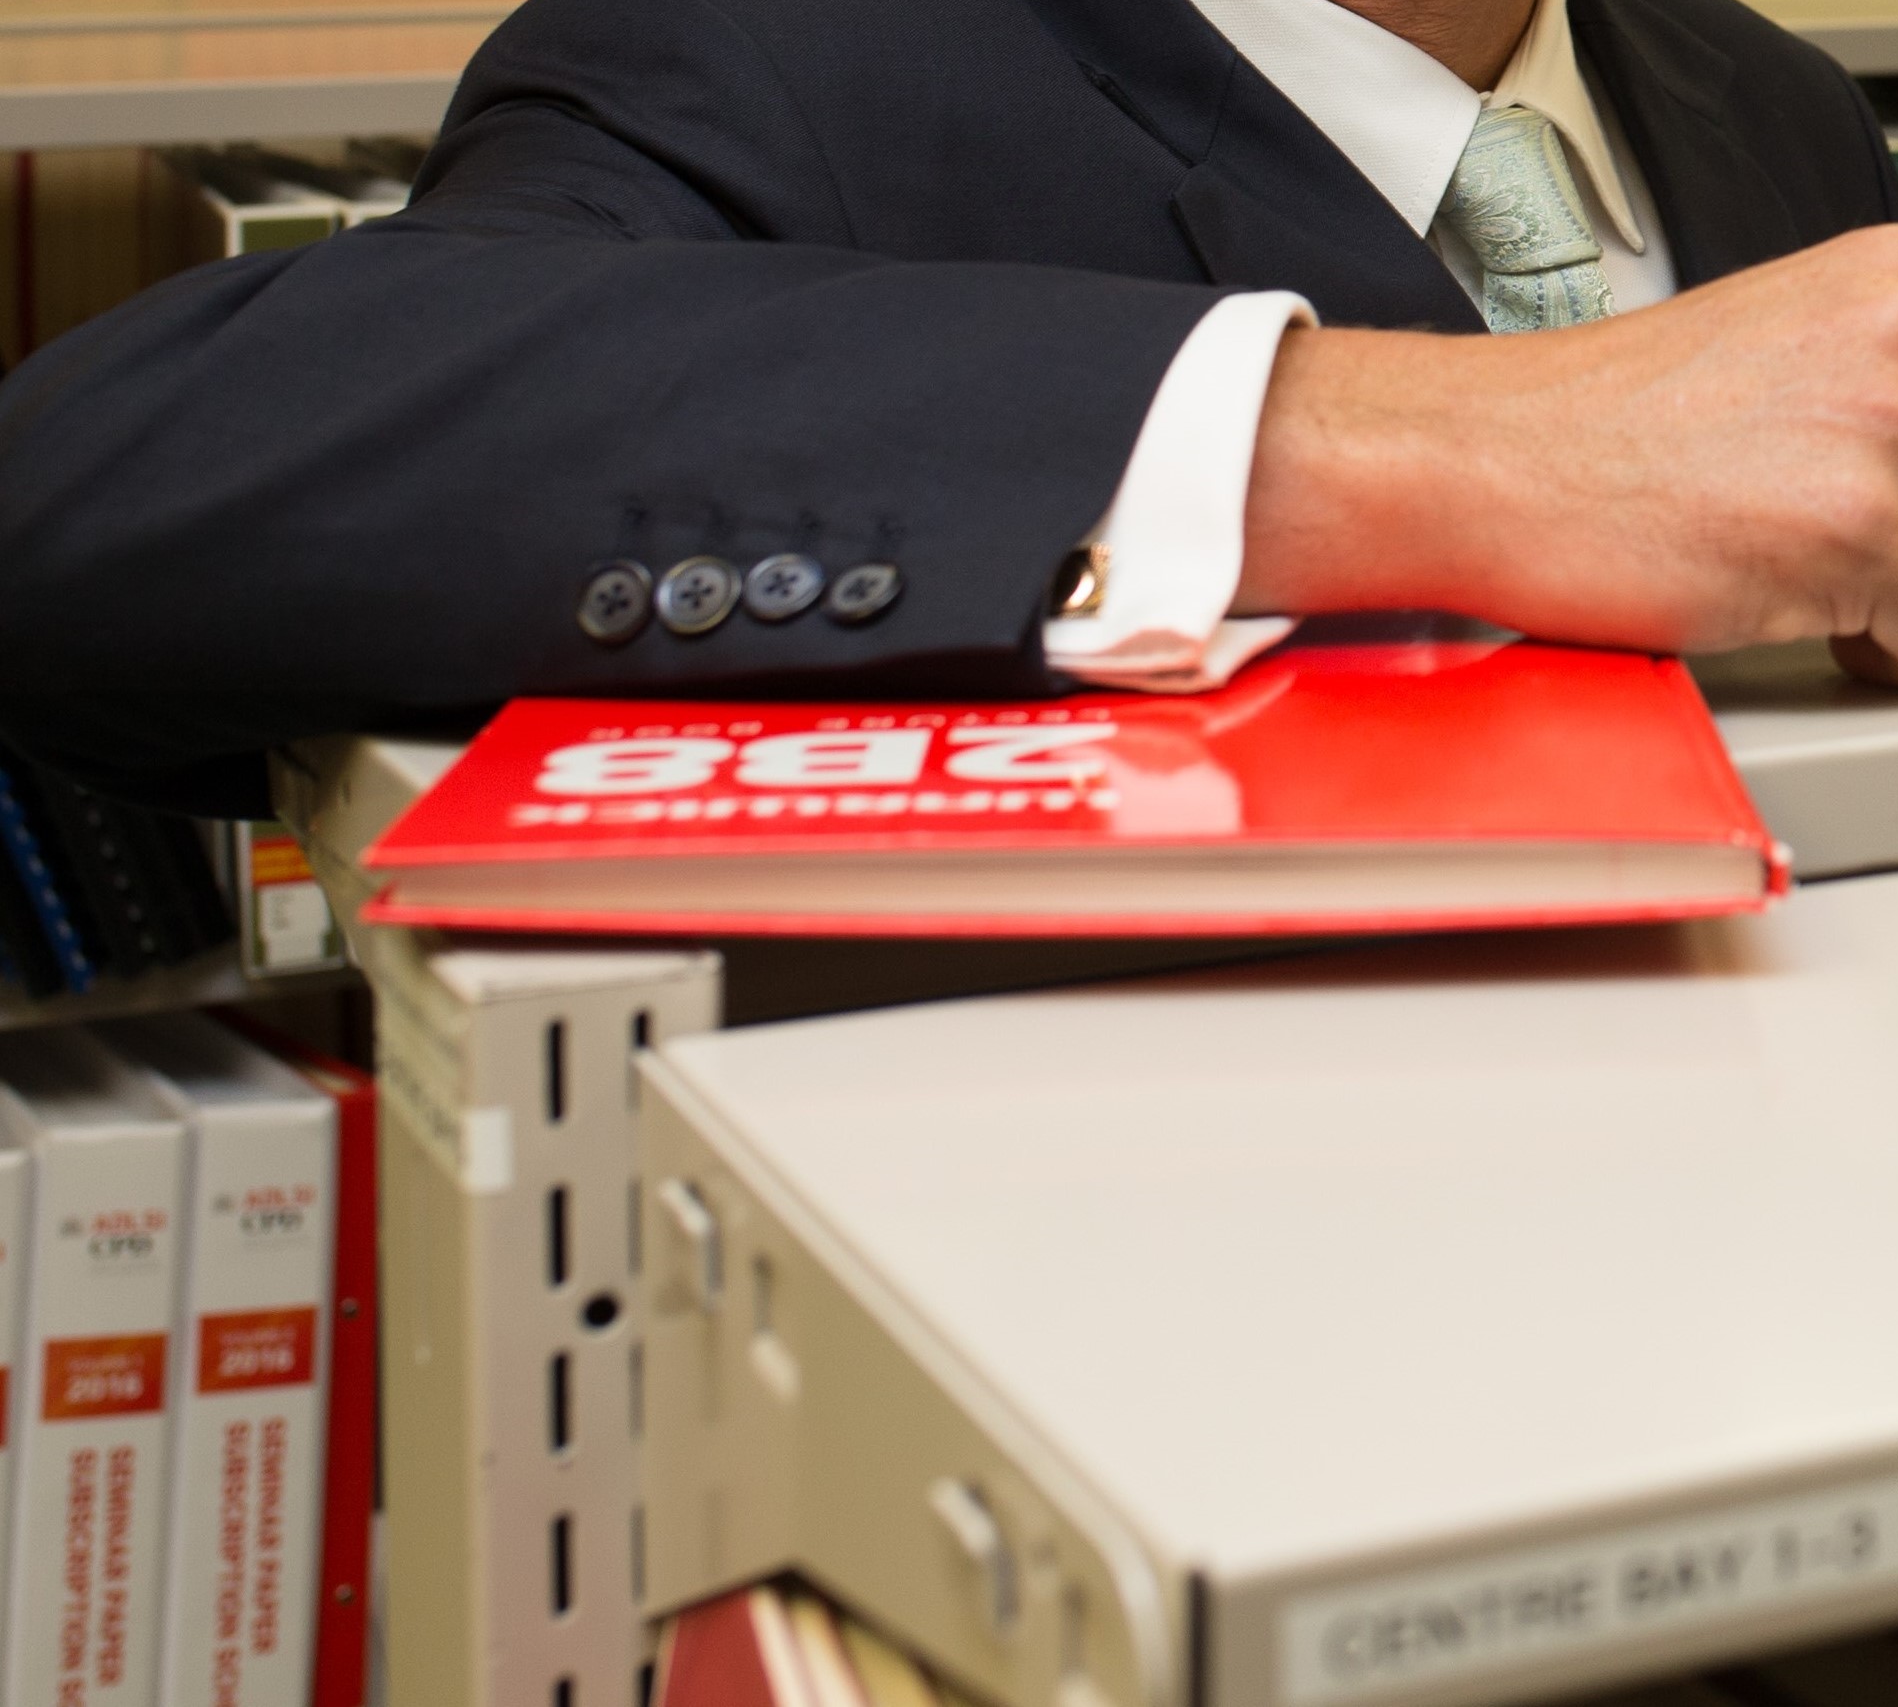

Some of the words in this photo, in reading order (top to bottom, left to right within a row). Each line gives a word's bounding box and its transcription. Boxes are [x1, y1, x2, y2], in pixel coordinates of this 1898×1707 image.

[534, 722, 1118, 794] 2B8
[107, 1446, 136, 1580] SEMINAR
[220, 1420, 249, 1639] SUBSCRIPTION
[257, 1416, 287, 1549] SEMINAR
[62, 1450, 97, 1670] SUBSCRIPTION
[253, 1557, 281, 1654] PAPER
[1320, 1564, 1597, 1685] CENTRE
[1617, 1538, 1755, 1620] BAY
[98, 1588, 127, 1685] PAPER
